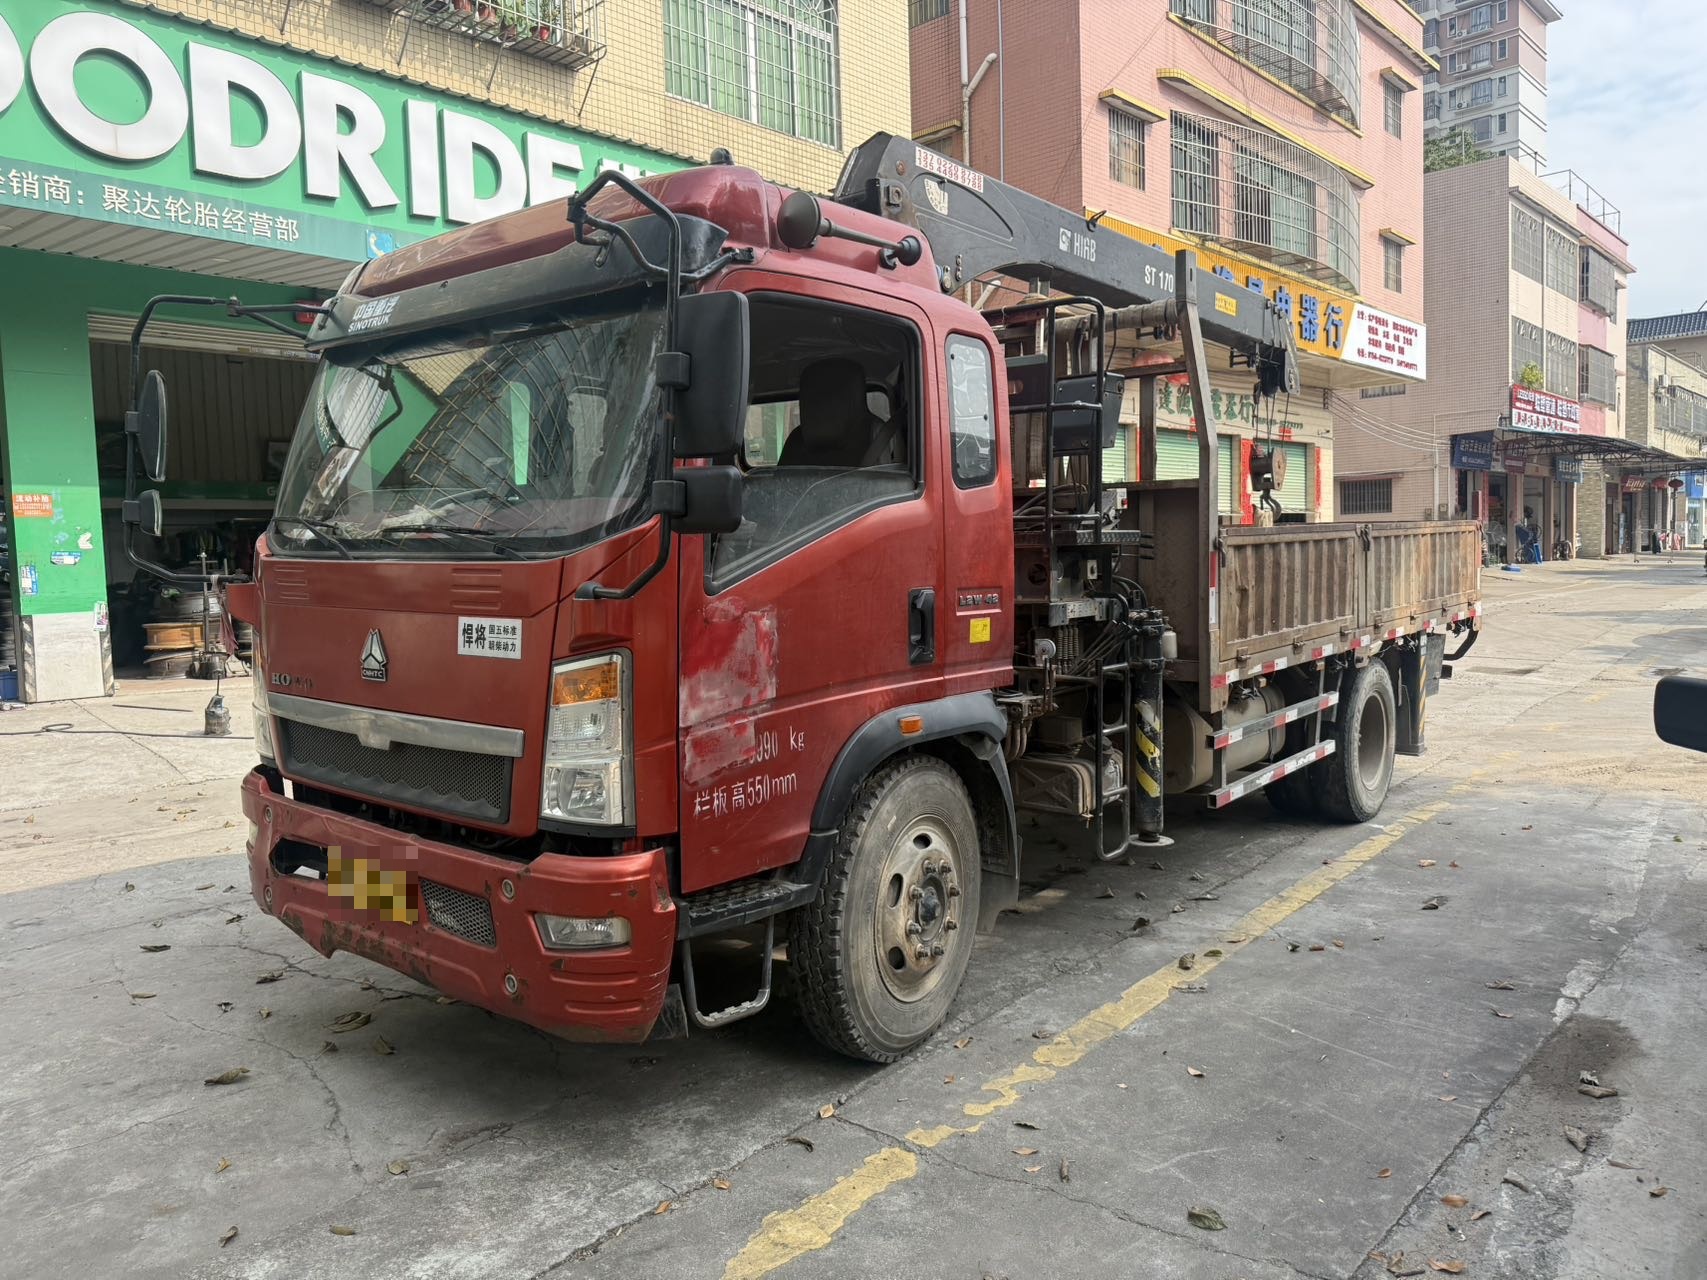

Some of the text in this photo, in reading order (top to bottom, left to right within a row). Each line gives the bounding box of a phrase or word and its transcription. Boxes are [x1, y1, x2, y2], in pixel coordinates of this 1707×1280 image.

[0, 10, 585, 226] ODRIDE
[0, 167, 299, 242] 销商：聚达轮胎经营部
[1144, 265, 1174, 293] ST 170
[347, 313, 392, 332] SINOTRUK
[462, 622, 518, 650] 悍将 国五标准
[488, 640, 518, 653] 朝柴动力
[362, 668, 384, 680] CNHTC
[789, 725, 805, 751] kg
